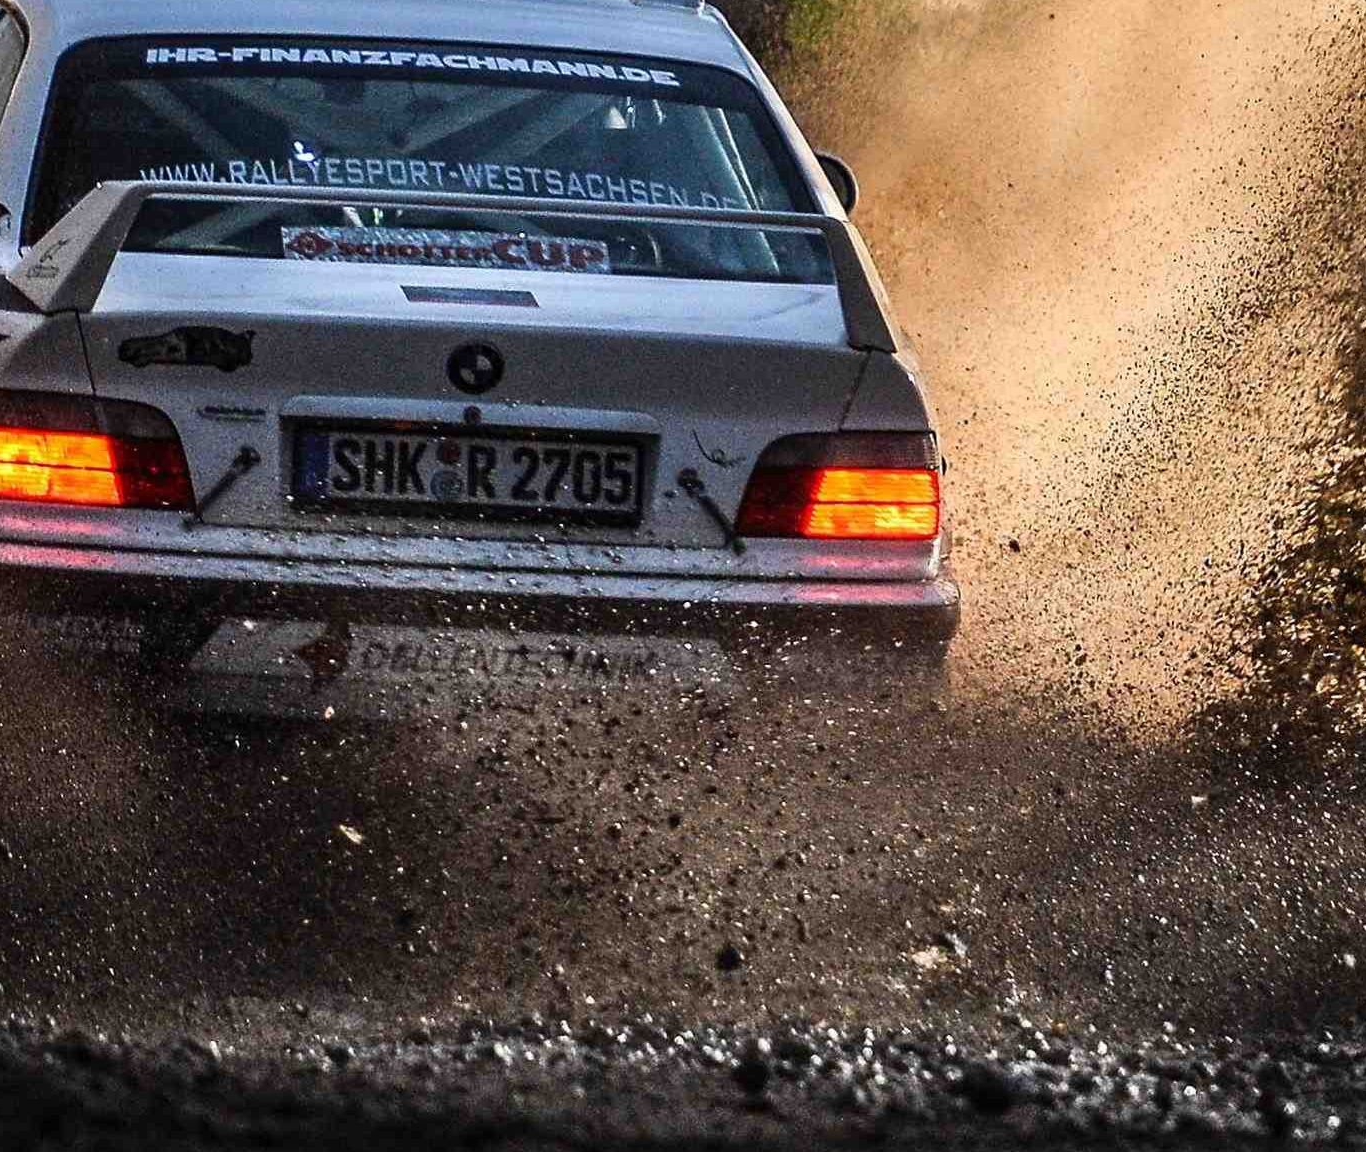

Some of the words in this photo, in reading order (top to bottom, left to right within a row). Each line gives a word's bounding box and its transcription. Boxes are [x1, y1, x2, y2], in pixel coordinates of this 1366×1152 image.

[146, 47, 680, 87] IHR-FINANZFACHMANN.DE
[138, 158, 737, 210] WWW.RALLYESPORT-WESTSACHSEND
[334, 438, 426, 494] SHK
[468, 445, 497, 499] R
[511, 448, 633, 504] 2705
